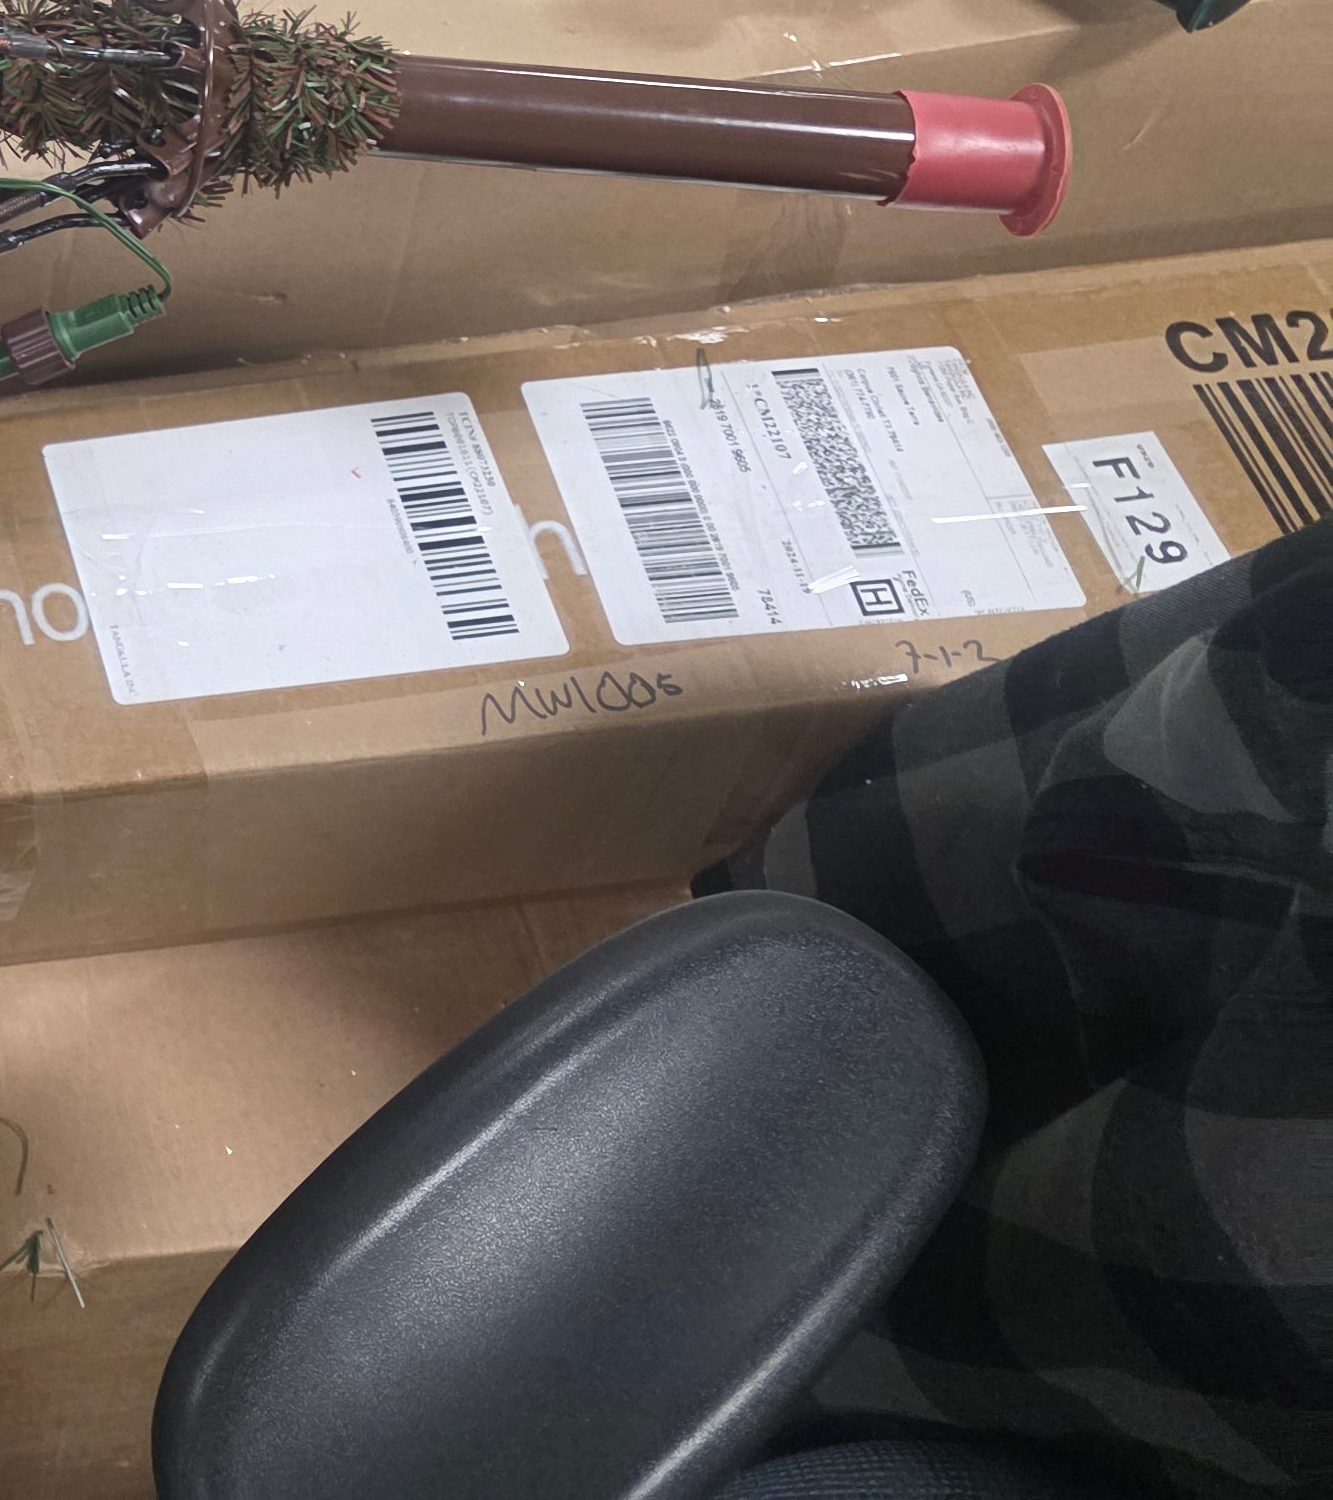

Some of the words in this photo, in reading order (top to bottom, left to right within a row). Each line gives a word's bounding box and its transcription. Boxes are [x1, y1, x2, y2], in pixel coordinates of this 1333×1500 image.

[1165, 310, 1333, 373] CM2
[719, 423, 740, 446] 7001
[730, 448, 752, 473] 9605
[1092, 456, 1188, 564] F129
[755, 588, 784, 625] 78414
[858, 586, 894, 606] H
[900, 569, 935, 616] FedEx
[895, 639, 1001, 674] 7-1-2
